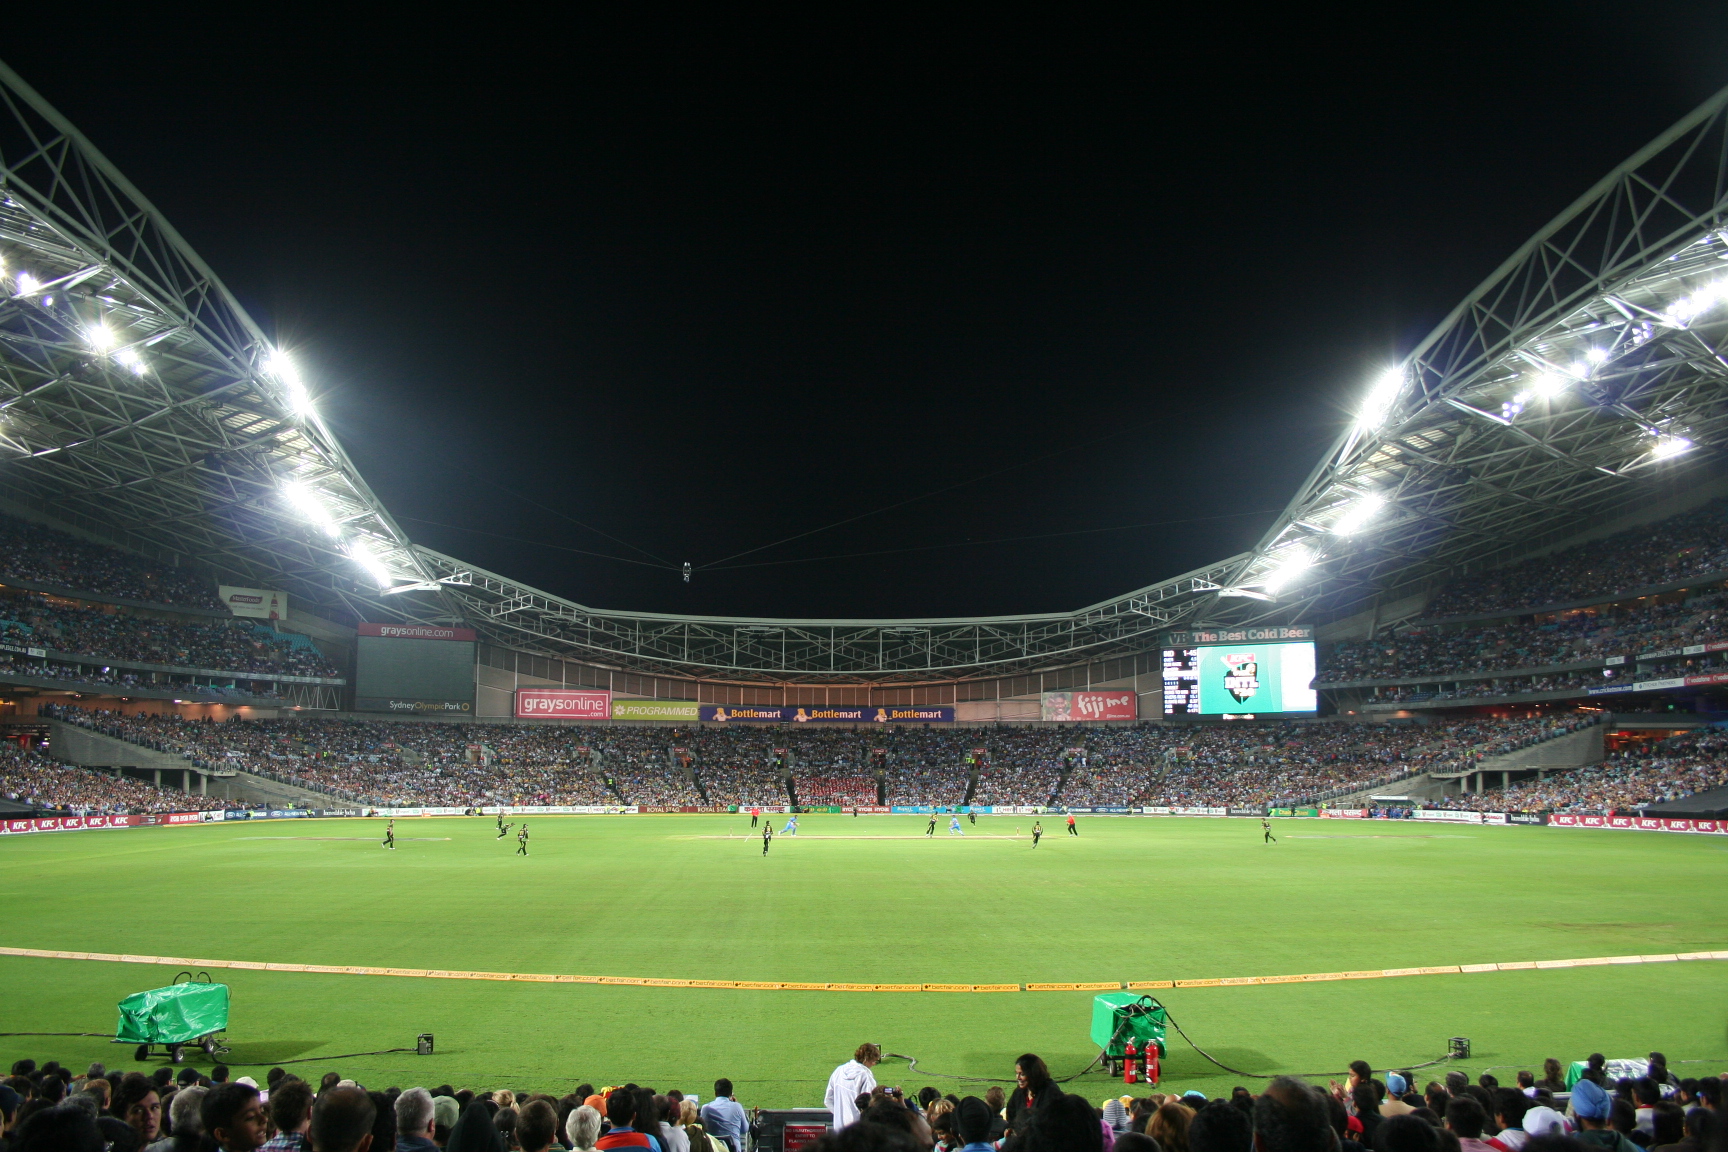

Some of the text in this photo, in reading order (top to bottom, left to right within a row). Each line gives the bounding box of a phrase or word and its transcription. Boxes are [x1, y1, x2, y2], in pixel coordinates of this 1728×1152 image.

[381, 626, 454, 638] graysonline.com
[1169, 627, 1310, 646] VB The Best Cold Beer
[1691, 676, 1710, 684] vodafone
[524, 697, 604, 712] graysonline
[1078, 694, 1129, 719] fiji me
[626, 706, 698, 717] PROGRAMMED
[731, 709, 781, 718] Bottlemart
[811, 709, 862, 718] Bottlemart
[892, 709, 942, 718] Bottlemart
[41, 819, 55, 829] KFC
[66, 818, 79, 828] KFC
[89, 817, 103, 827] KFC
[114, 816, 129, 825] KFC
[1559, 816, 1573, 824] KFC
[1585, 816, 1600, 825] KFC
[1612, 818, 1627, 827] KFC
[1641, 819, 1657, 828] KFC
[12, 821, 28, 831] KFC
[1670, 821, 1686, 829] KFC
[1698, 821, 1712, 830] KFC
